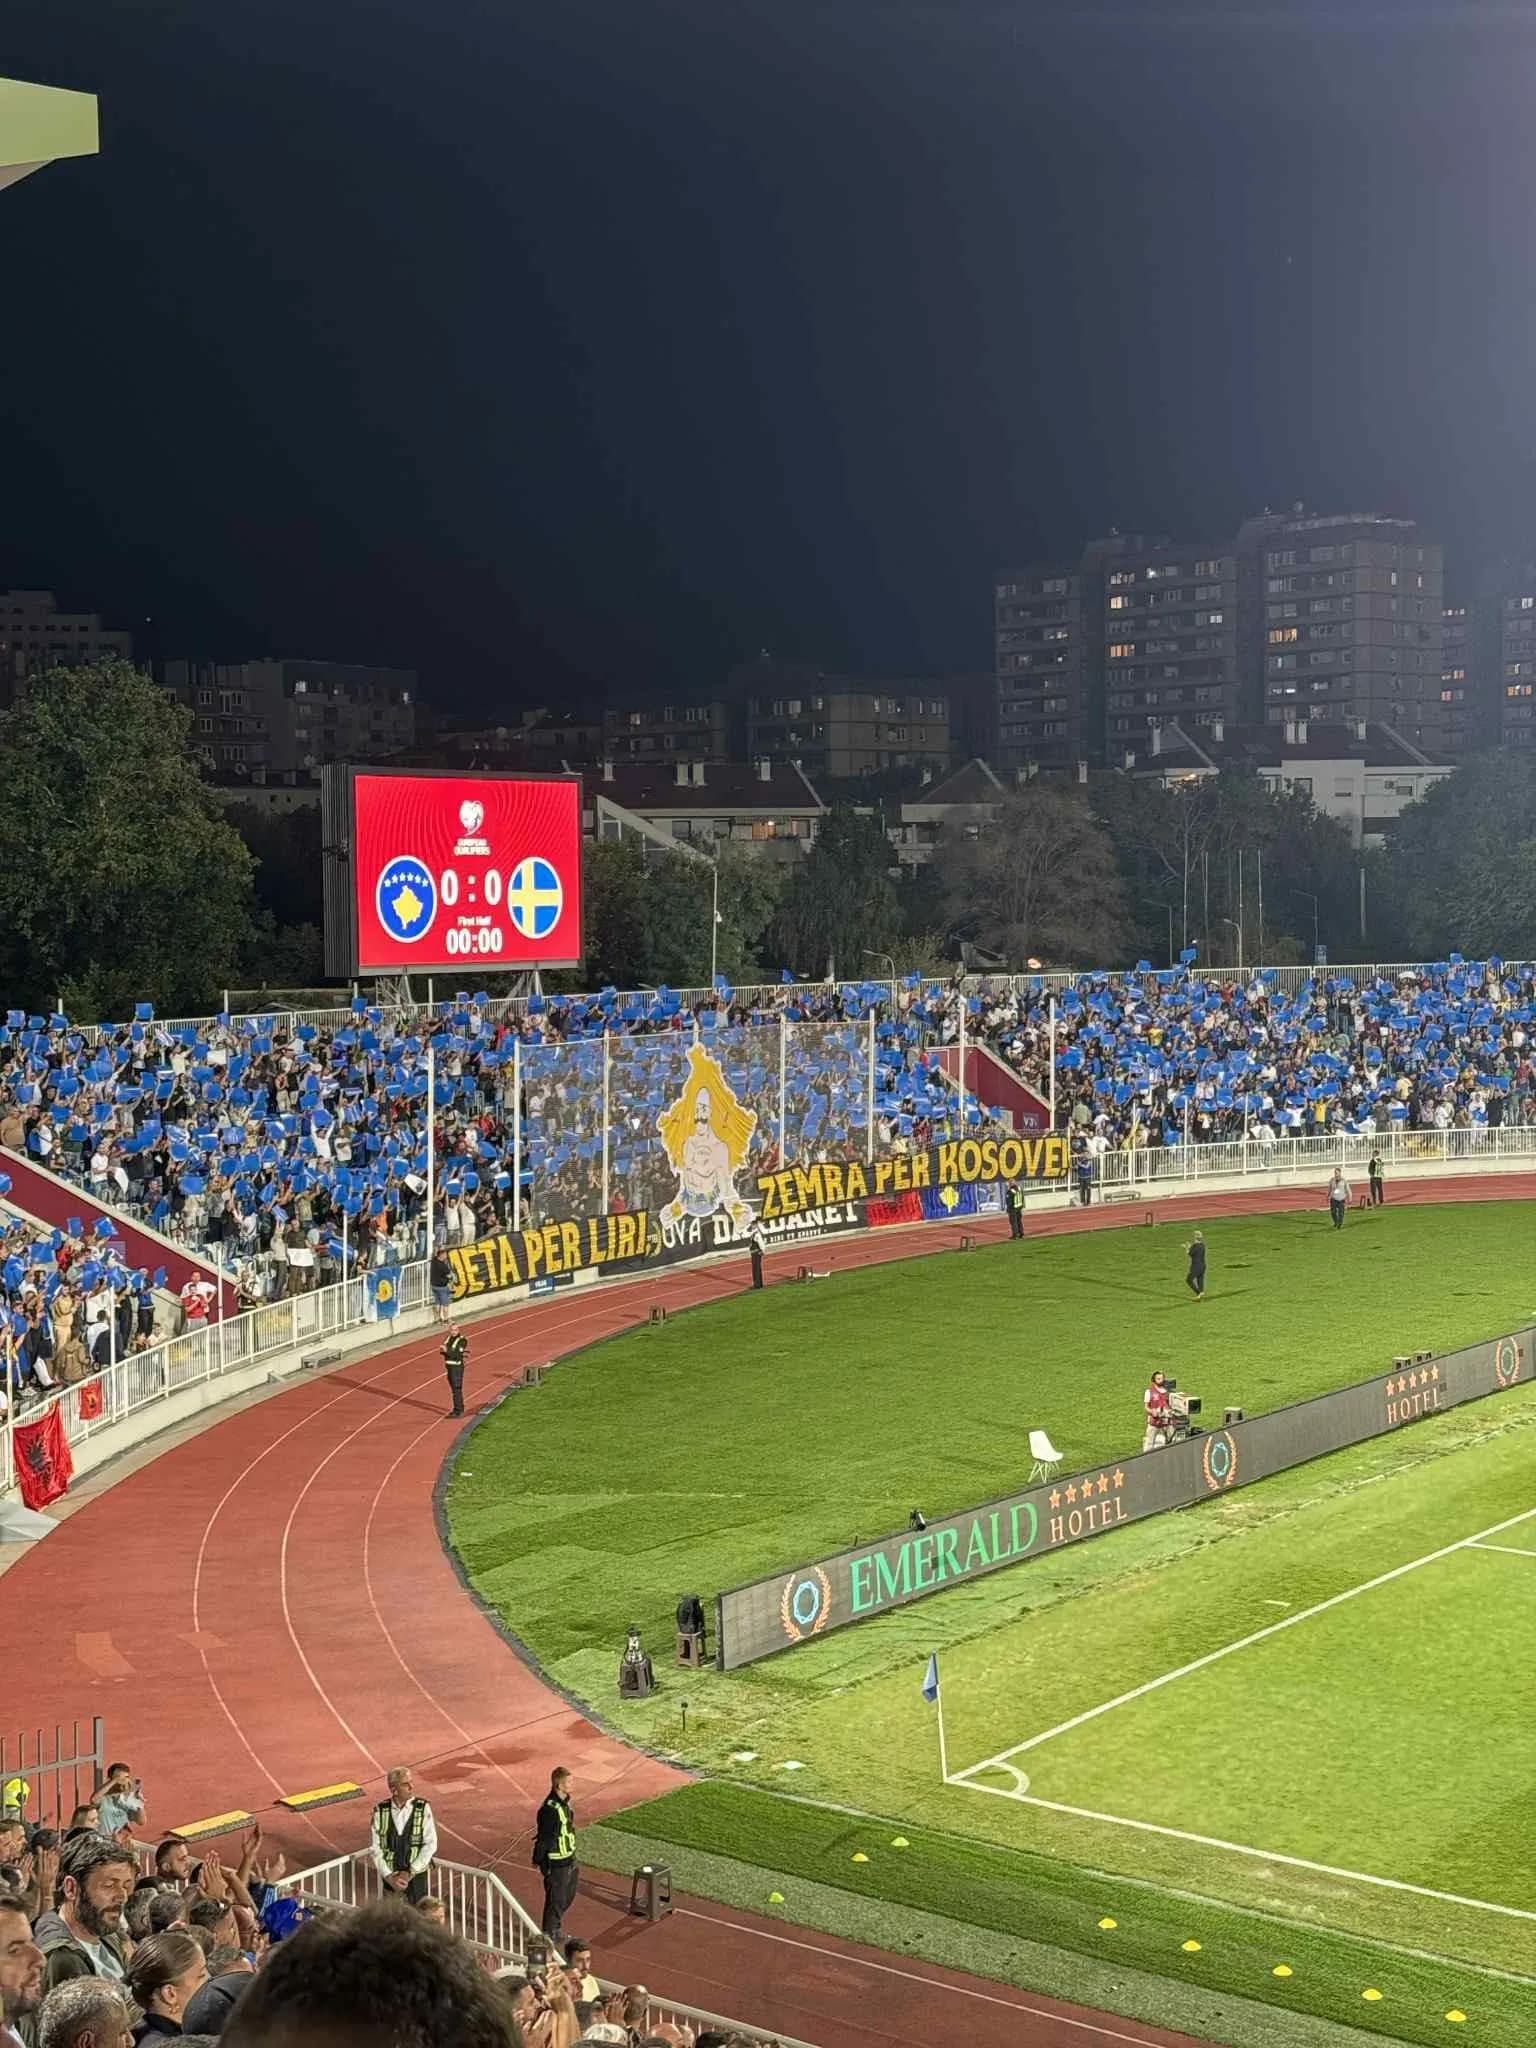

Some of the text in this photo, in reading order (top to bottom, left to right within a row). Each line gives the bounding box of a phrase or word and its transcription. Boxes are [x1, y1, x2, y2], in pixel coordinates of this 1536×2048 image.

[441, 869, 459, 906] 0
[484, 869, 502, 906] 0
[446, 928, 502, 954] 00:00
[758, 1162, 868, 1219] ZEMRA
[449, 1235, 522, 1298] JETA
[588, 1212, 647, 1265] LIRI
[1387, 1388, 1442, 1424] HOTEL
[850, 1496, 1127, 1613] EMERALD HOTEL
